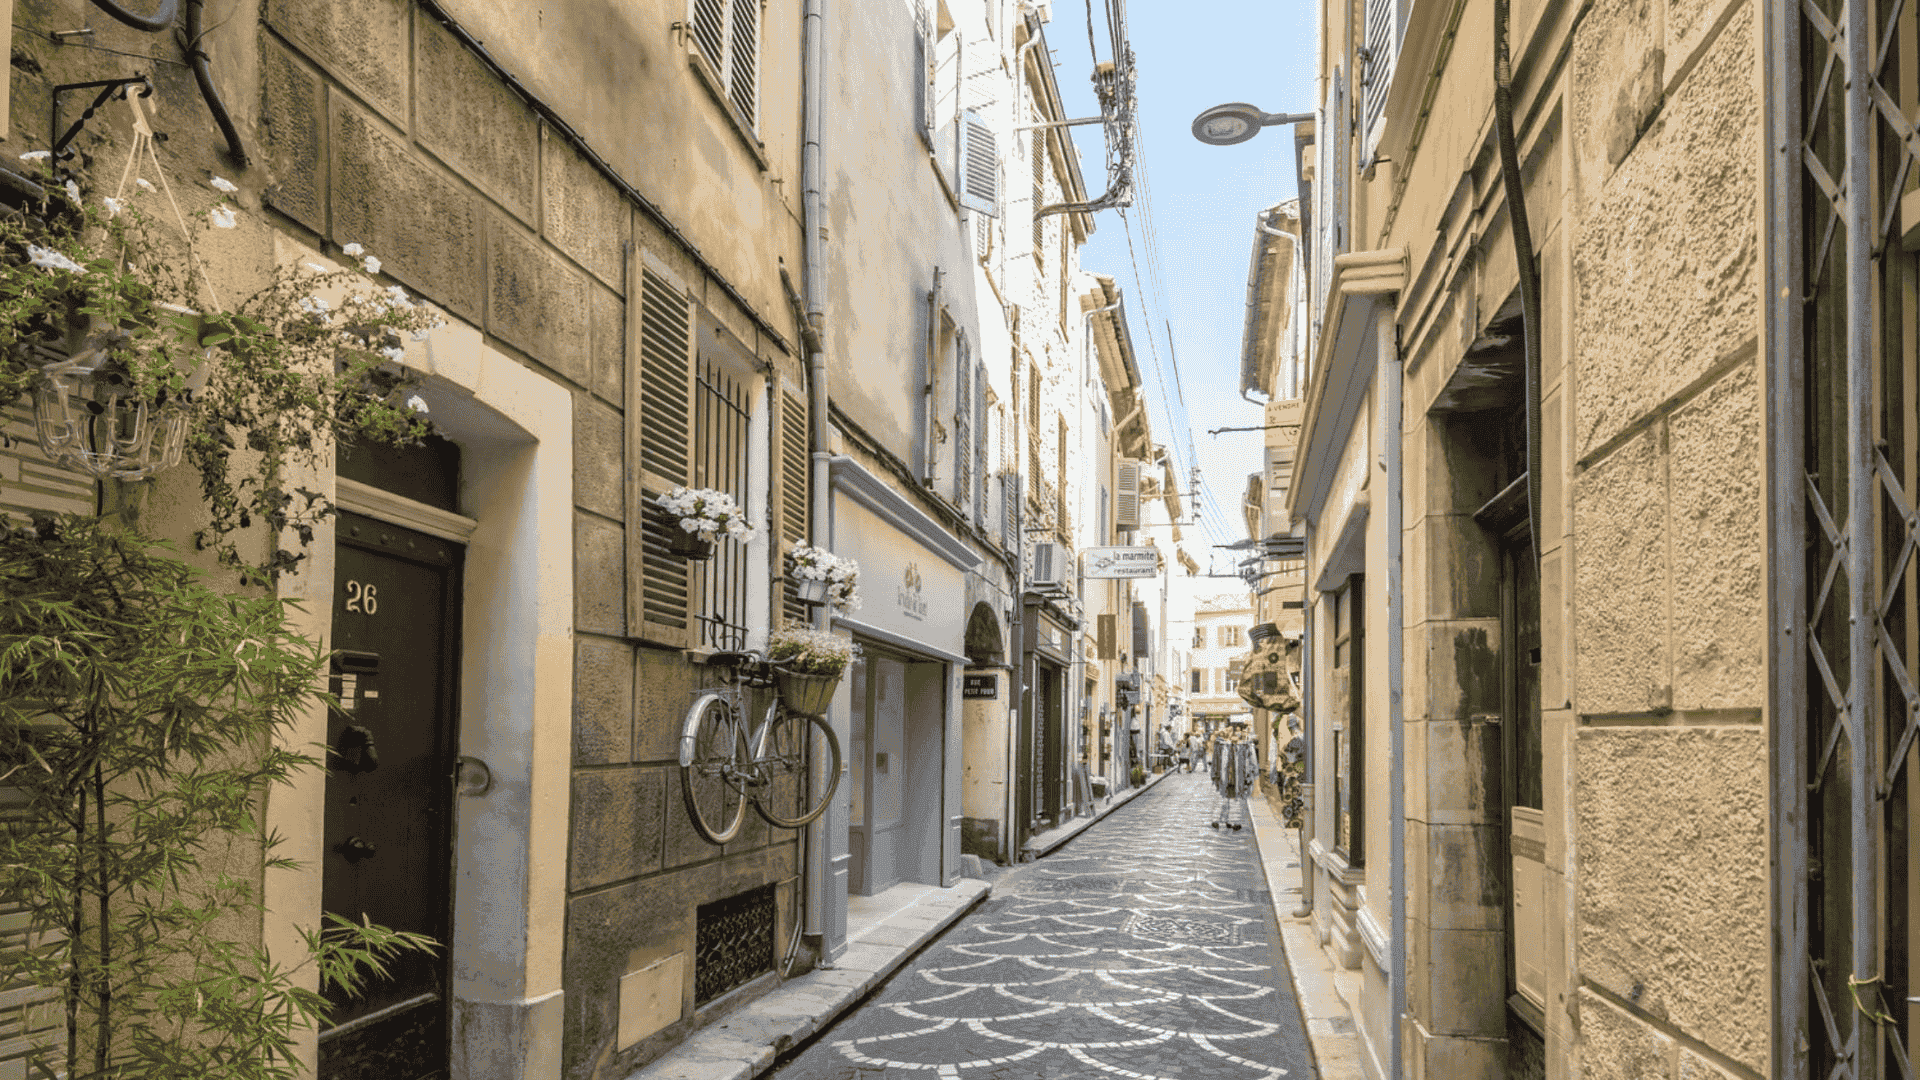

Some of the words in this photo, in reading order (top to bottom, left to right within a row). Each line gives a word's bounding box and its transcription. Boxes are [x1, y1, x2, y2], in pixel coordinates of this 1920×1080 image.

[1113, 551, 1121, 561] la
[1122, 552, 1155, 561] marmite
[346, 580, 377, 614] 26
